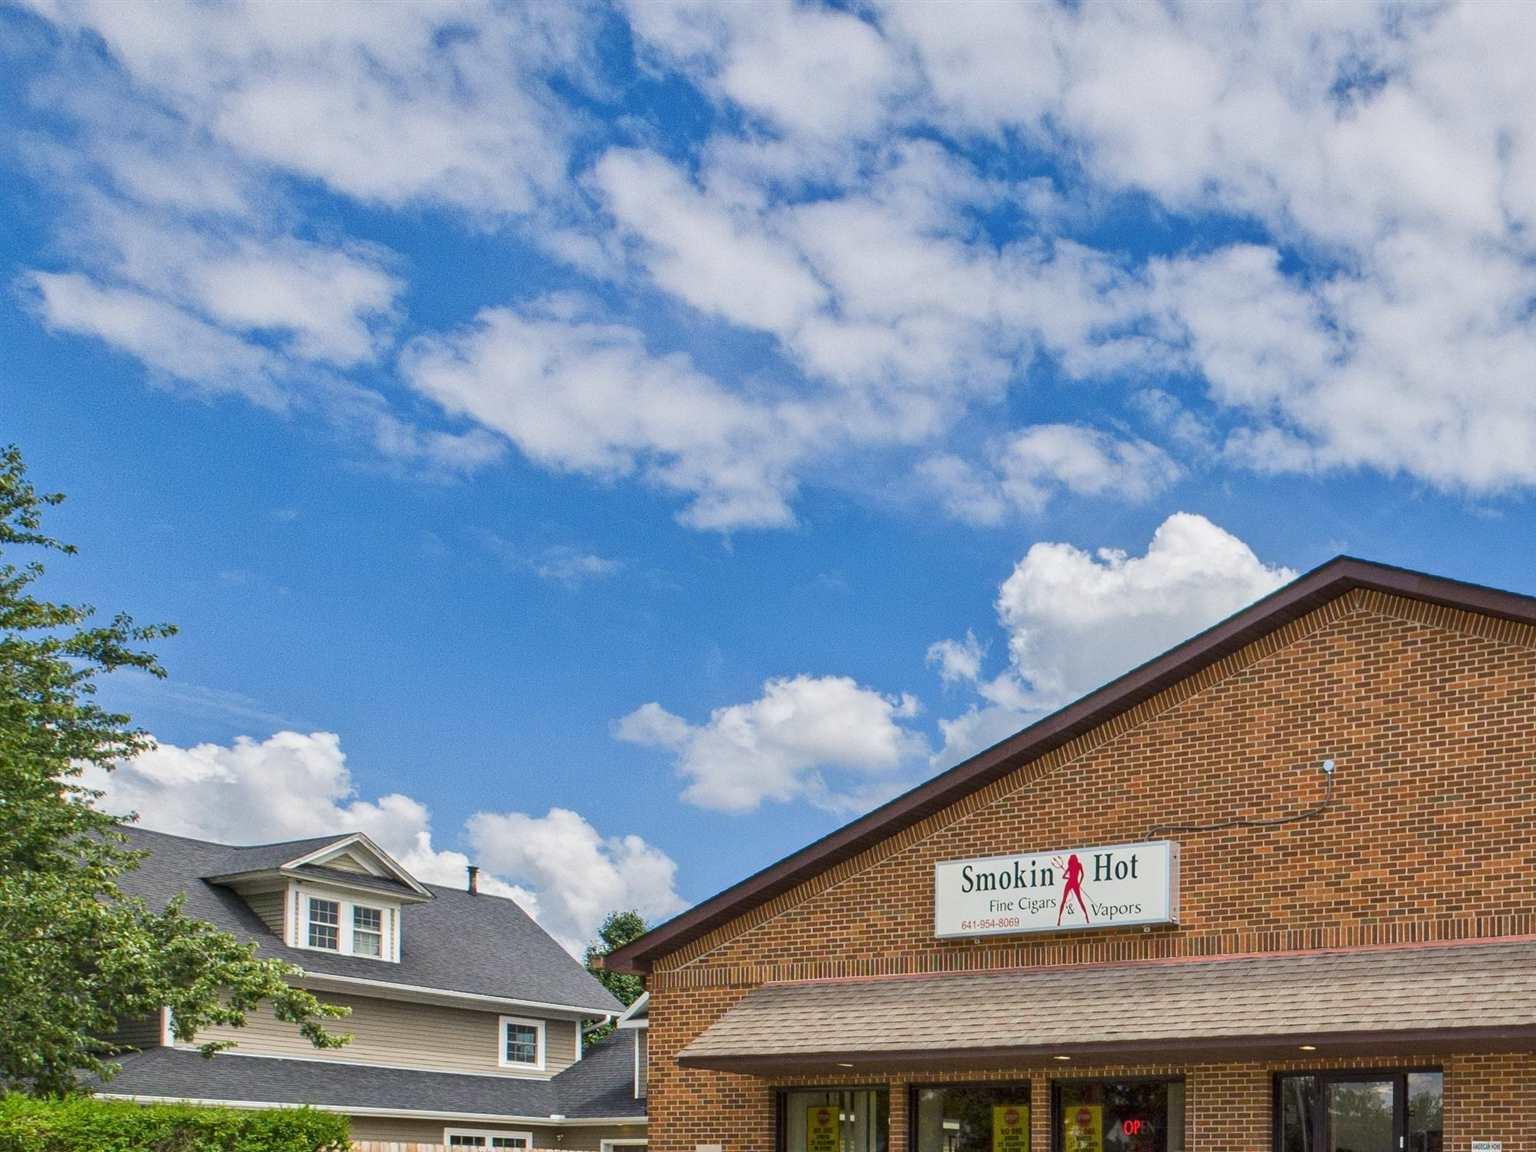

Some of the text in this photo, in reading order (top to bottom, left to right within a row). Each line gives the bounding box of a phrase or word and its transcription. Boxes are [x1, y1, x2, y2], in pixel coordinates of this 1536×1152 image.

[961, 853, 1139, 893] Smokin Hot
[989, 896, 1142, 921] Fine Cigars & Vapors
